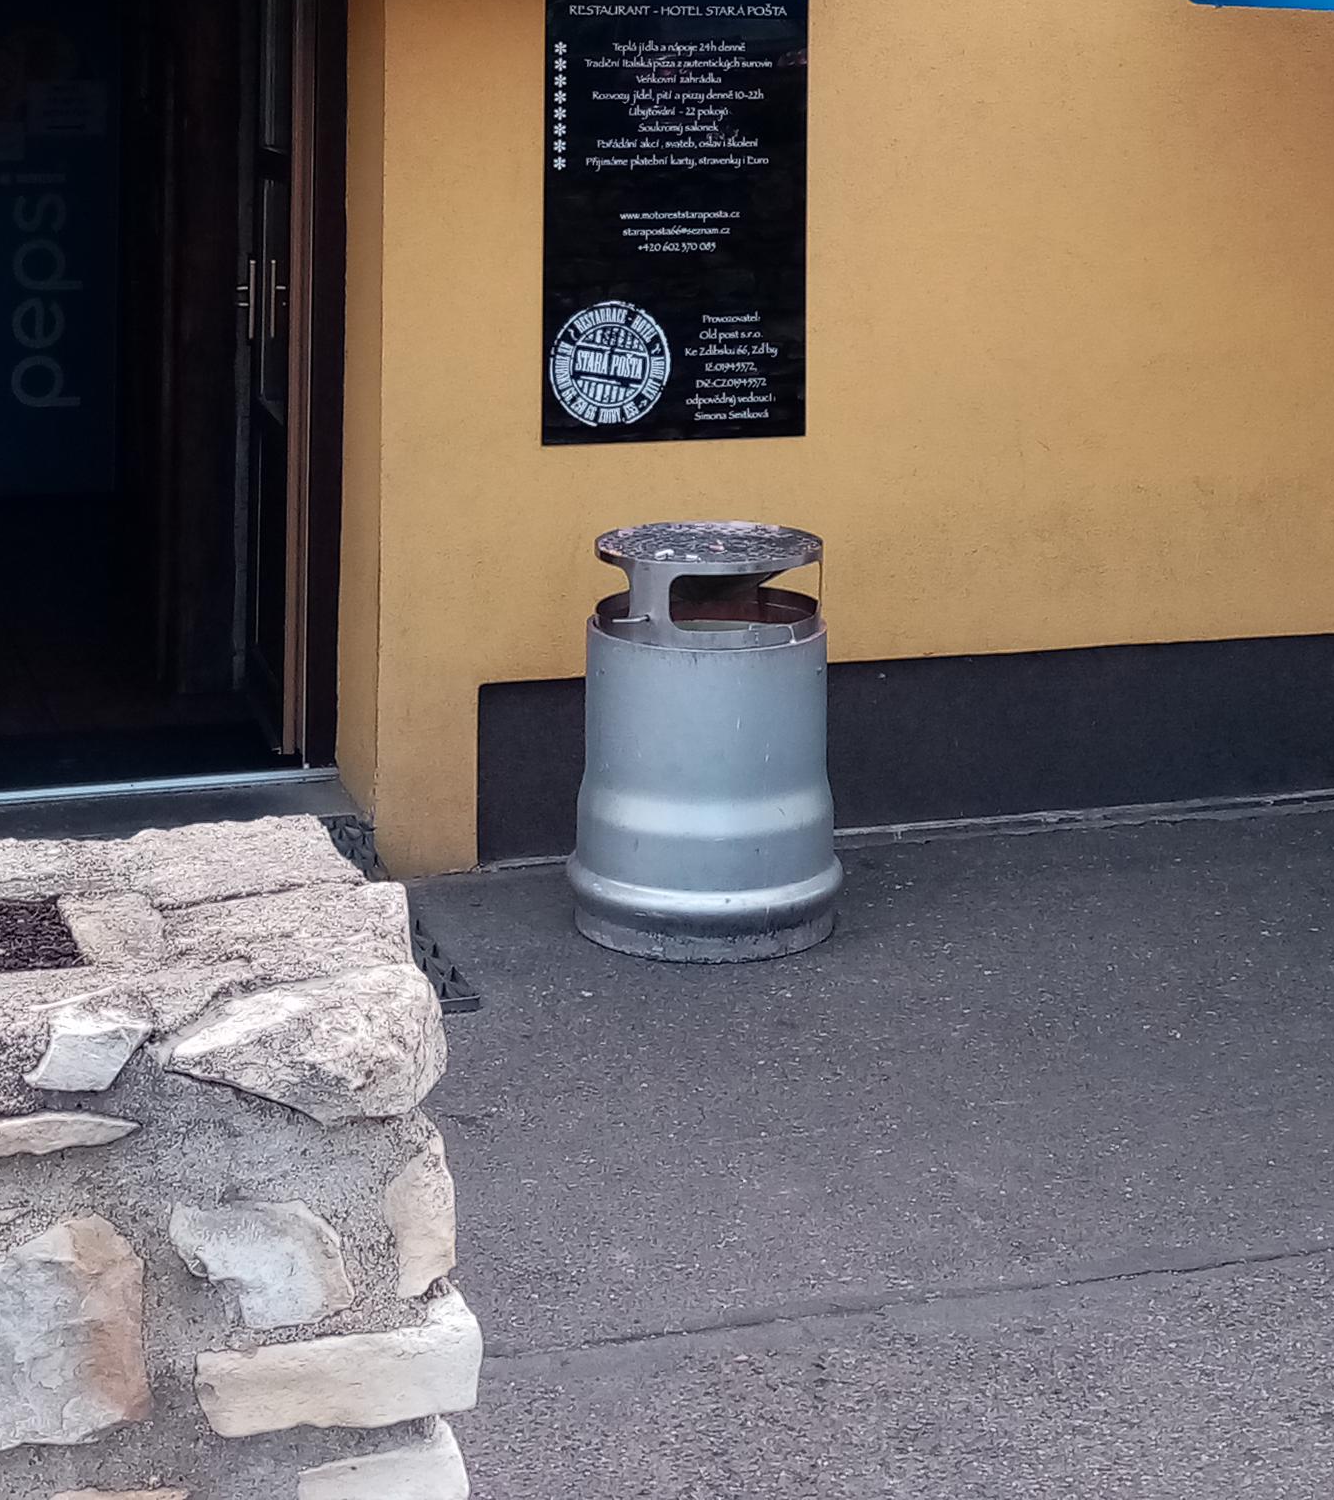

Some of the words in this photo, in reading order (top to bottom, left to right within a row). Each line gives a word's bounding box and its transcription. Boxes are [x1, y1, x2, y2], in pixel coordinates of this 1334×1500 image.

[568, 4, 651, 16] RESTAURANT
[660, 4, 704, 16] HOTEL
[705, 3, 746, 17] STARÁ
[747, 2, 788, 17] POŠTA
[612, 39, 637, 57] Teplá
[636, 39, 659, 58] jídla
[660, 44, 667, 52] a
[667, 41, 698, 58] nápoje
[717, 39, 746, 52] denně
[583, 56, 620, 68] Tradiční
[683, 56, 740, 72] autentických
[741, 58, 773, 68] surovin
[679, 71, 722, 84] zahrádka
[591, 89, 630, 104] Rozvozy
[674, 92, 681, 100] a
[681, 90, 705, 105] pizzy
[705, 87, 734, 100] denně
[734, 87, 765, 100] 10-22h
[628, 104, 677, 120] Ubytování
[685, 106, 697, 116] 22
[697, 104, 729, 122] pokojů
[637, 120, 684, 137] Soukromý
[684, 120, 719, 132] salonek
[596, 136, 638, 149] Pořádání
[726, 136, 759, 148] školení
[630, 153, 669, 171] platební
[698, 153, 741, 169] stravenky
[746, 155, 770, 166] Euro
[662, 241, 680, 252] 602
[573, 307, 628, 334] RESTAURACE
[630, 314, 658, 344] HOTEL
[698, 327, 718, 340] Old
[718, 329, 740, 344] post
[740, 330, 764, 339] s.r.o.
[684, 347, 698, 357] Ke
[574, 349, 611, 375] STARÁ
[609, 353, 643, 380] POŠTA
[685, 391, 737, 410] odpovědný
[694, 410, 728, 421] Simona
